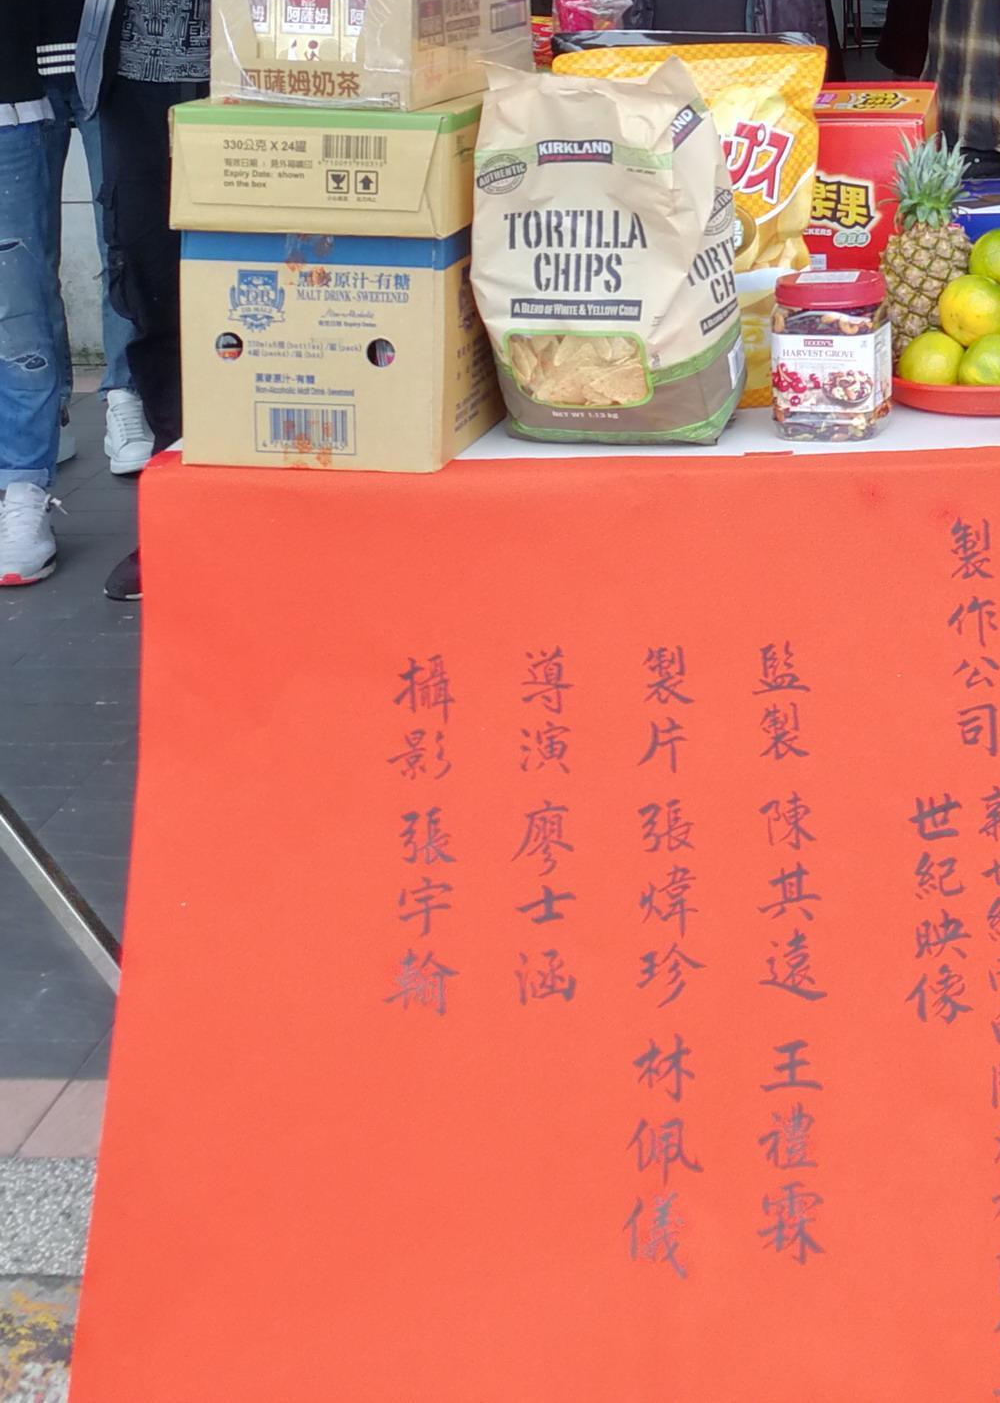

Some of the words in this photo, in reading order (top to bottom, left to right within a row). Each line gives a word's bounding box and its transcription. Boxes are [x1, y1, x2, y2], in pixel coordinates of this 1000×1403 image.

[241, 68, 361, 98] 阿薩姆奶茶
[223, 169, 249, 180] Expiry
[478, 163, 526, 188] AUTHENTIC
[538, 141, 612, 156] KIRKLAND
[504, 209, 648, 250] TORTILLA
[533, 253, 623, 293] CHIPS
[296, 289, 321, 301] MALT
[324, 291, 351, 302] DRINK
[513, 303, 520, 313] A
[521, 303, 544, 314] BLEND
[553, 304, 577, 315] WHITE
[579, 304, 586, 315] &
[587, 304, 618, 315] YELLOW
[782, 349, 823, 357] HARVEST
[824, 349, 856, 358] GROVE
[948, 518, 999, 756] 製作公司
[387, 654, 455, 779] 攝影
[520, 646, 574, 774] 導演
[638, 645, 695, 774] 製片
[753, 641, 811, 760] 監製
[384, 806, 459, 1016] 張宇翰
[512, 800, 577, 1006] 廖士涵
[637, 799, 706, 1008] 張煒珍
[758, 792, 828, 1002] 陳其遠
[906, 792, 974, 1025] 世紀映像
[624, 1033, 704, 1279] 林佩儀
